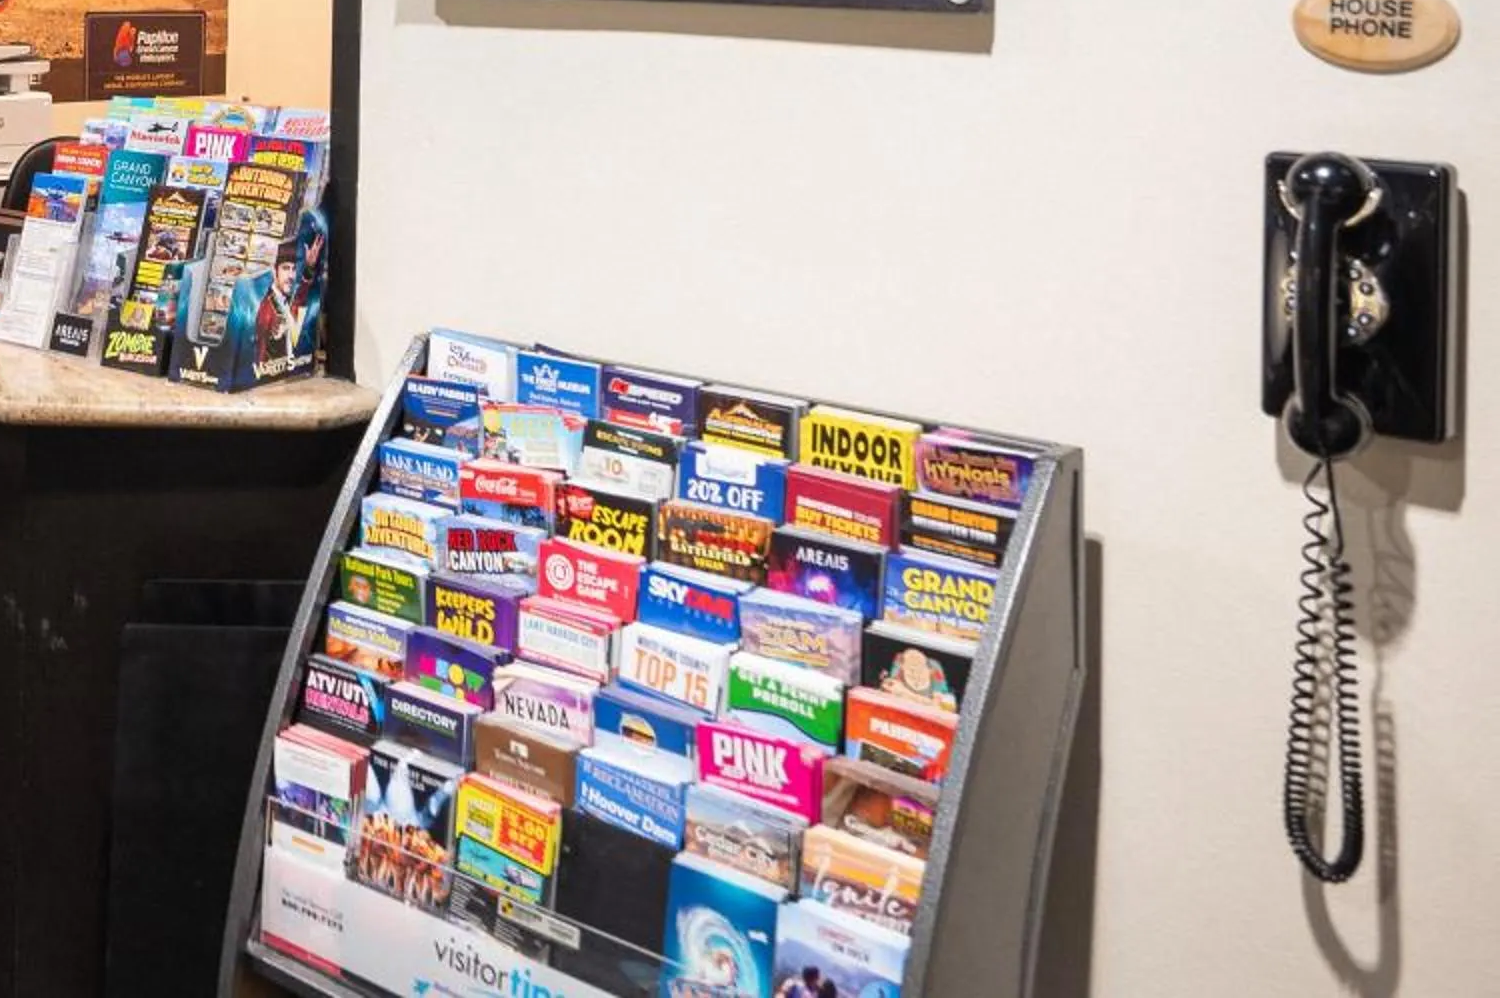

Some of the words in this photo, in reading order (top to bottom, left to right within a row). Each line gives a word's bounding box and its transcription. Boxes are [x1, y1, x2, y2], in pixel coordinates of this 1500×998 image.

[1329, 17, 1413, 39] PHONE
[195, 132, 237, 160] PINK
[111, 171, 157, 188] CANYON
[113, 159, 152, 175] GRAND
[104, 331, 156, 359] ZOMBIE
[193, 345, 209, 371] V
[812, 422, 902, 470] INDOOR
[687, 478, 723, 504] 20%
[727, 486, 764, 512] OFF
[591, 505, 649, 533] ESCAPE
[824, 511, 881, 542] TICKETS
[569, 517, 645, 556] ROOM
[450, 550, 505, 573] CANYON
[435, 586, 496, 621] KEEPERS
[902, 567, 995, 606] GRAND
[904, 589, 990, 623] CANYON
[634, 648, 677, 691] TOP
[683, 671, 708, 708] 15
[391, 697, 457, 731] DIRECTORY
[504, 690, 571, 730] NEVADA
[712, 731, 790, 784] PINK
[588, 788, 639, 823] Hoover
[641, 810, 678, 843] Dam
